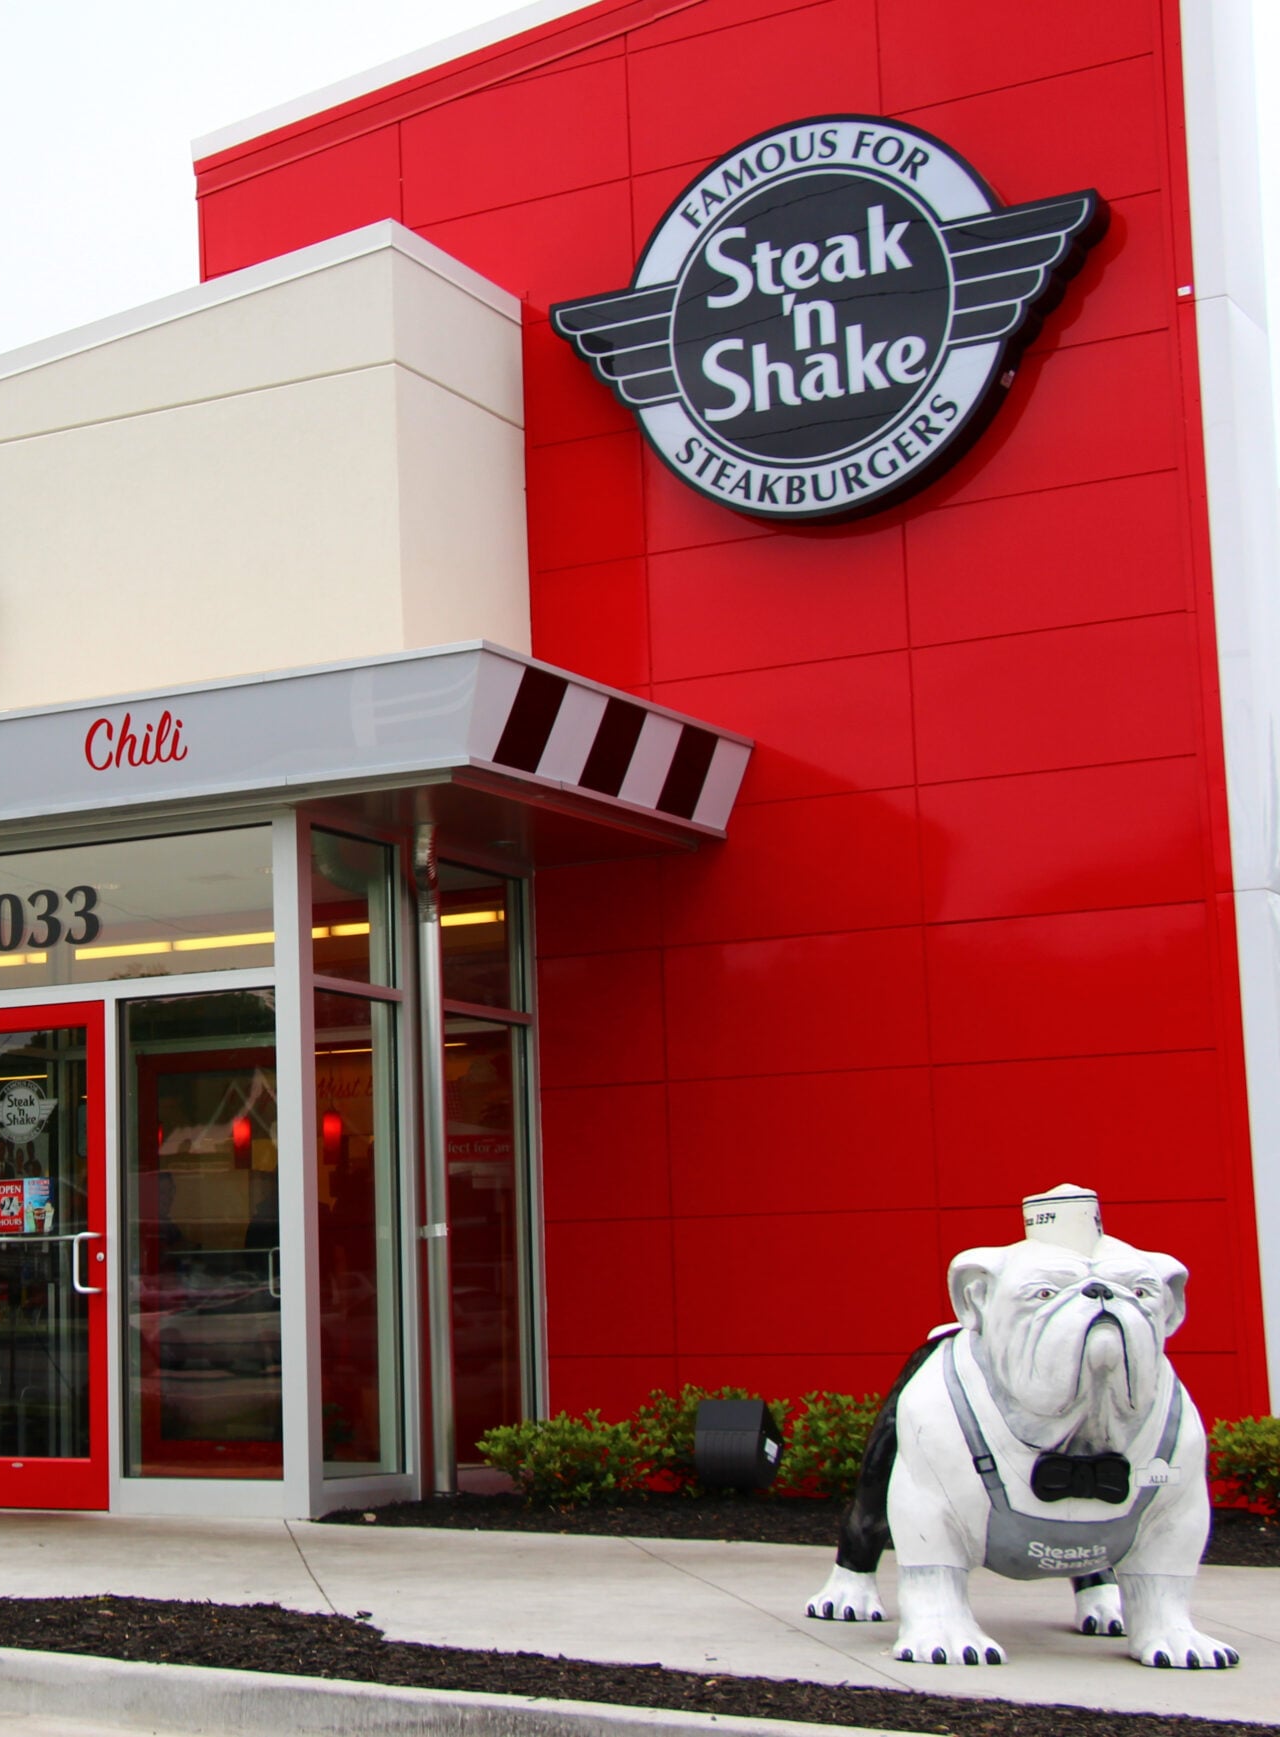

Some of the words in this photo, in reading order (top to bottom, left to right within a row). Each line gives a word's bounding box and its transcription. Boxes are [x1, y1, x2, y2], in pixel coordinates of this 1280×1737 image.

[680, 129, 838, 229] FAMOUS
[851, 130, 930, 182] FOR
[705, 204, 913, 309] Steak
[782, 292, 836, 352] 'n
[701, 323, 927, 422] Shake
[675, 393, 960, 505] STEAKBURGERS
[84, 710, 188, 771] Chili
[6, 1112, 37, 1126] Shake
[7, 1095, 35, 1108] Steak
[1035, 1212, 1056, 1225] 1934
